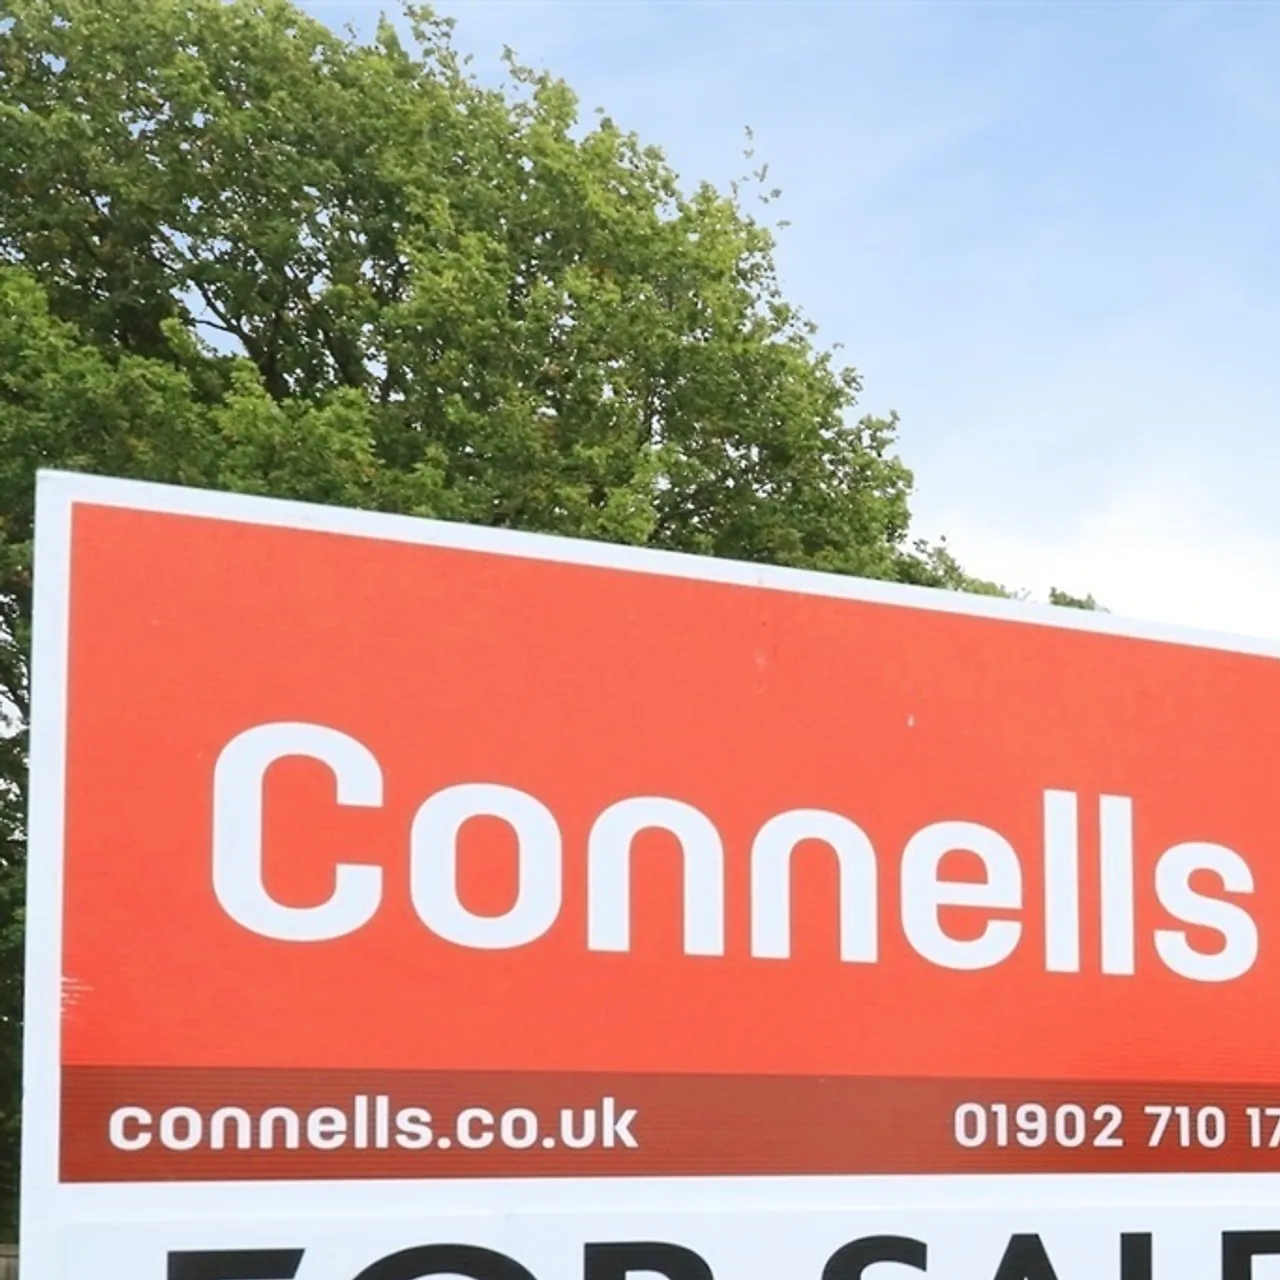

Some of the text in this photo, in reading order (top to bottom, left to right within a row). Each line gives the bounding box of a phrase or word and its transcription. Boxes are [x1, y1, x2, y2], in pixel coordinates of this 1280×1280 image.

[211, 721, 1259, 983] Connells
[108, 1094, 639, 1151] connells.co.uk
[954, 1102, 1124, 1148] 01902
[1144, 1105, 1226, 1148] 710
